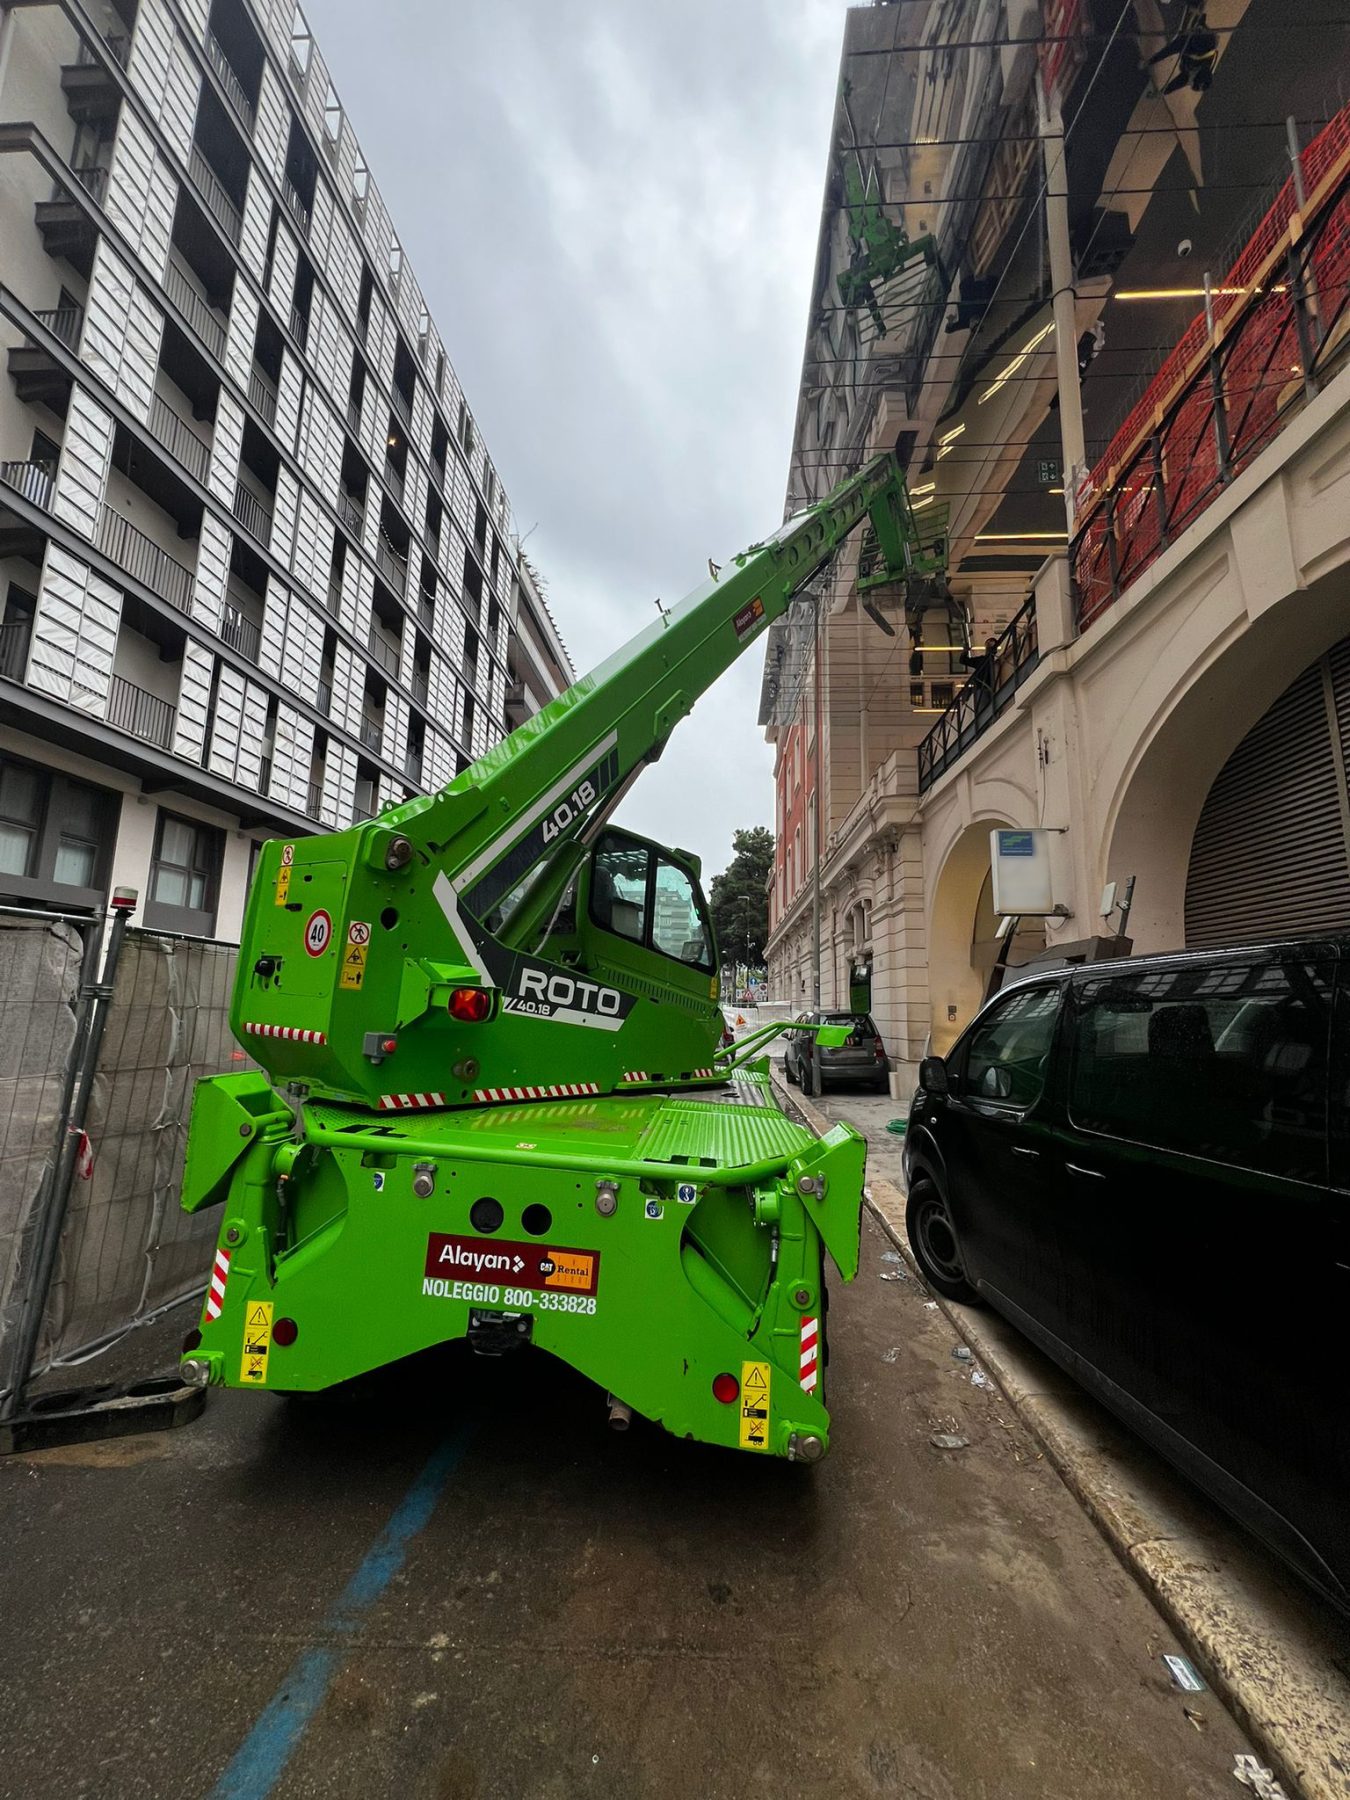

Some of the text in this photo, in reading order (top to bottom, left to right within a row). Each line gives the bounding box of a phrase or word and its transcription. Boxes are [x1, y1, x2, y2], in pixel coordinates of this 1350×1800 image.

[542, 780, 596, 844] 40.18
[310, 923, 325, 943] 40
[518, 967, 621, 1016] ROTO
[516, 999, 551, 1016] 40.18
[438, 1243, 511, 1273] Alayan
[539, 1262, 589, 1277] CAT Rental
[421, 1278, 597, 1315] NOLEGGIO 800-333828
